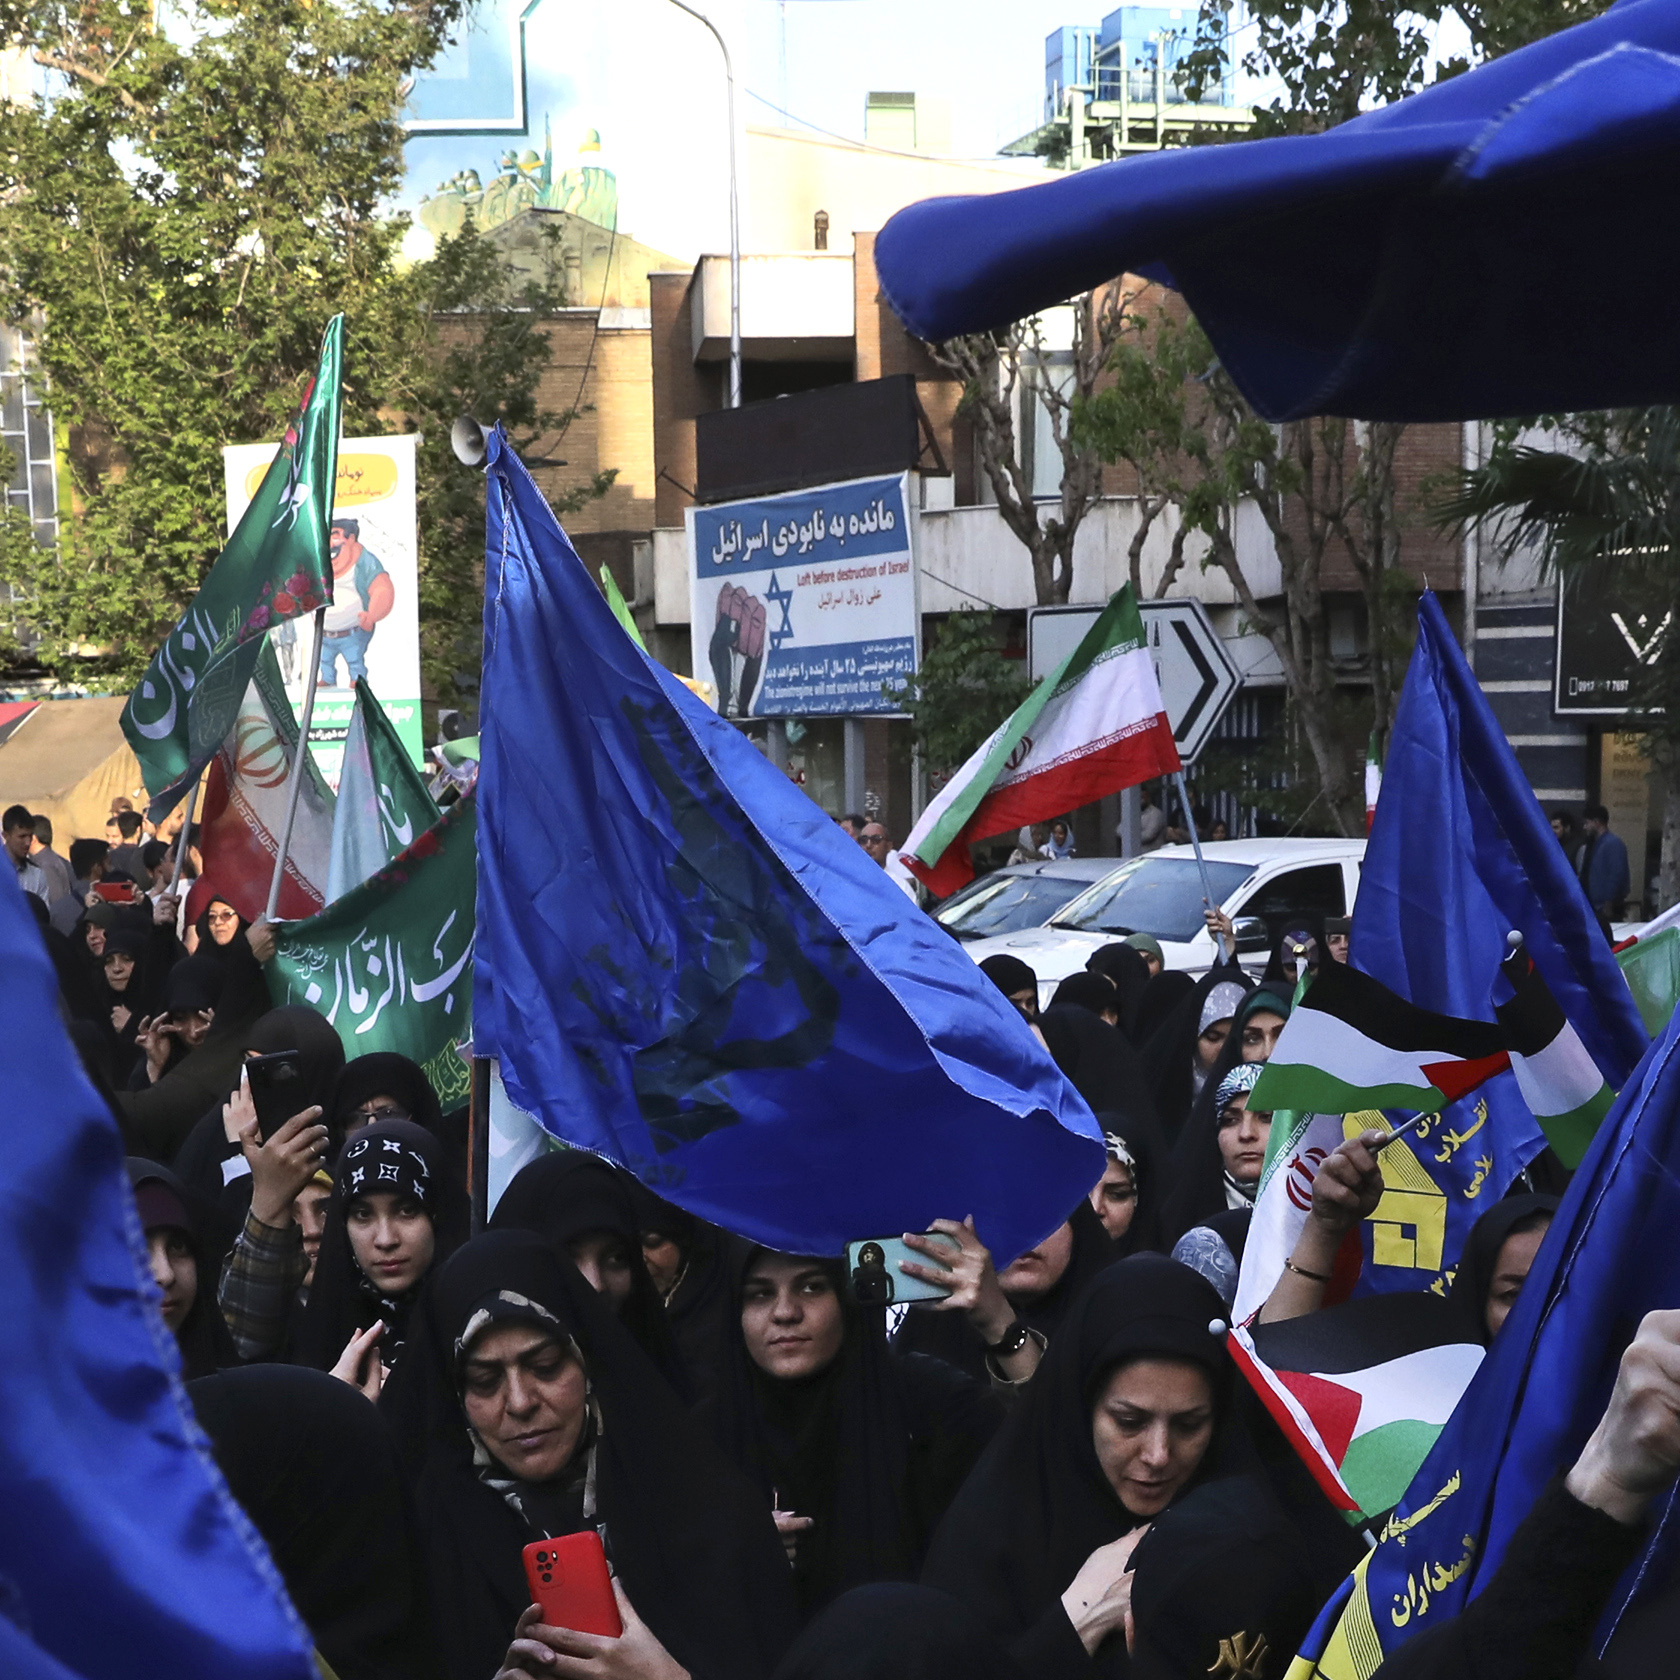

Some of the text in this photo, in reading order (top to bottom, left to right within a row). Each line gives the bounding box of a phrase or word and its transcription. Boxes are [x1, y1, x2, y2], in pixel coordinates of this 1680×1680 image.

[712, 499, 895, 564] مانده به نابودی اسرائیل
[812, 569, 835, 584] before
[836, 565, 877, 581] destruction
[879, 561, 887, 576] of
[888, 559, 910, 575] Israel
[764, 685, 775, 699] The
[814, 681, 826, 696] will
[826, 682, 837, 695] not
[837, 680, 859, 695] survive
[859, 679, 870, 693] the
[1434, 1097, 1489, 1163] انقلاب
[1463, 1151, 1493, 1199] لامی
[1379, 1469, 1460, 1547] سپاه
